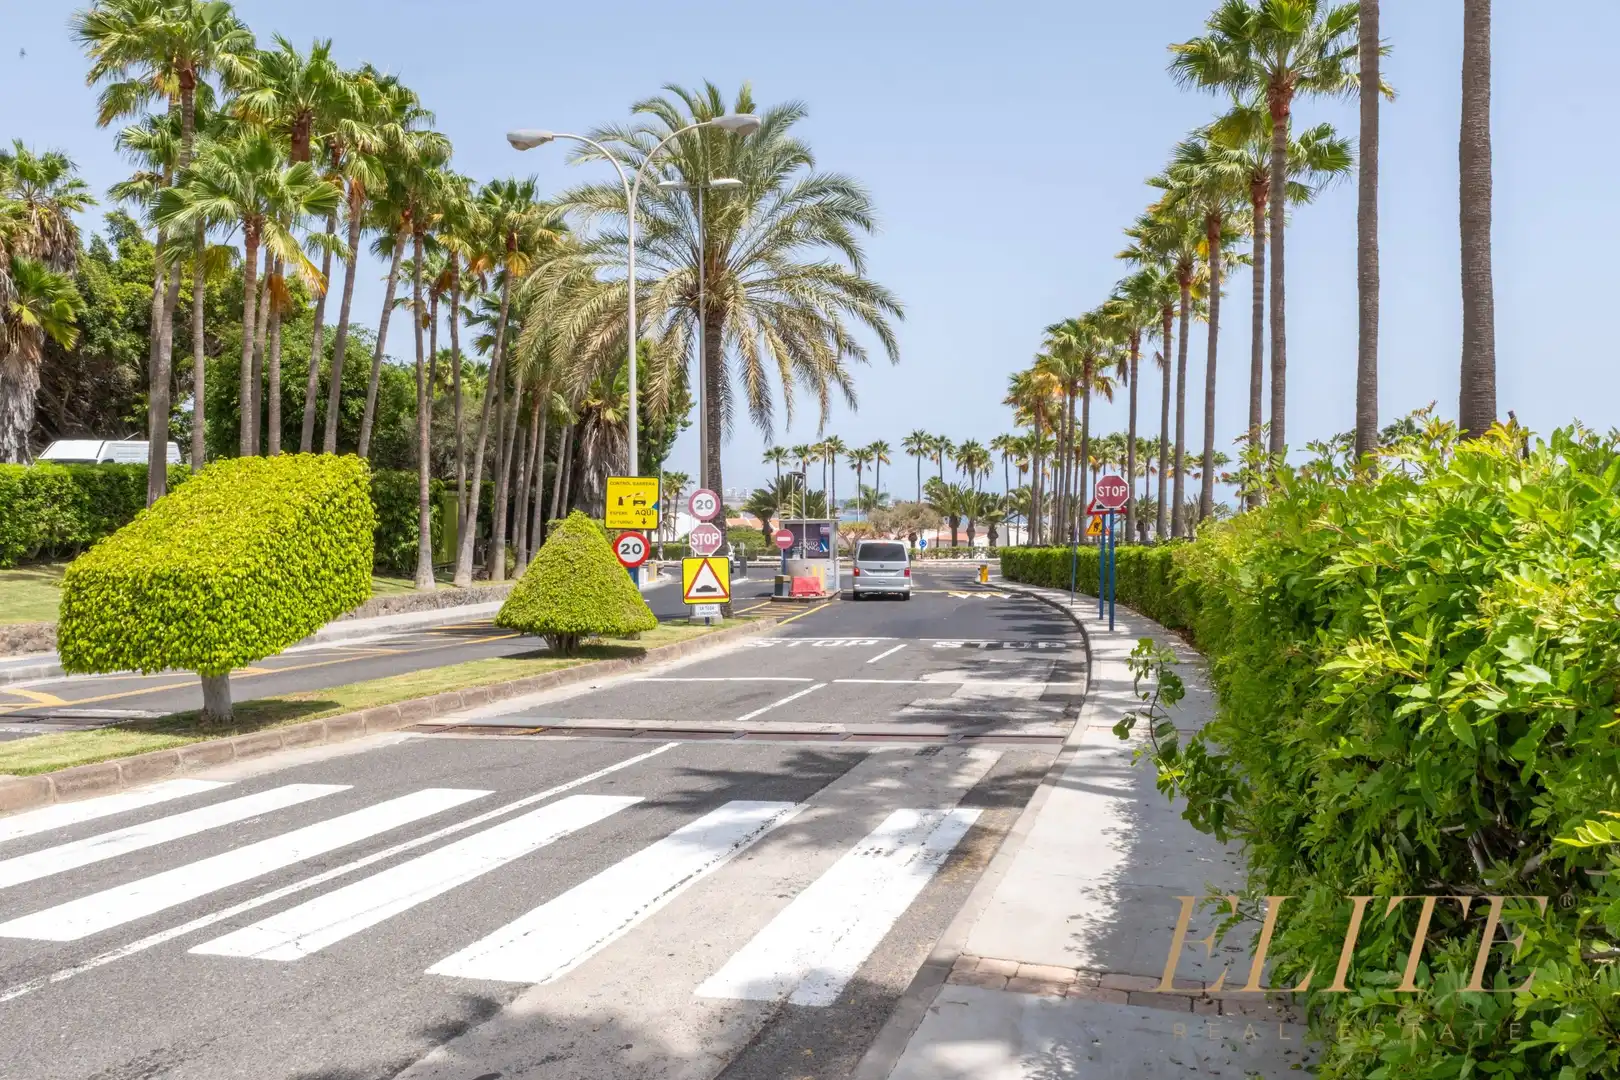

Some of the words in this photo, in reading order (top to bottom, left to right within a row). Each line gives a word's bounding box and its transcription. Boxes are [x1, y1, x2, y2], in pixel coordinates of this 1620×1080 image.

[1098, 485, 1127, 497] STOP
[695, 499, 714, 510] 20
[691, 533, 720, 545] STOP
[620, 543, 642, 555] 20
[743, 640, 880, 648] STOP
[931, 641, 1067, 649] STOP
